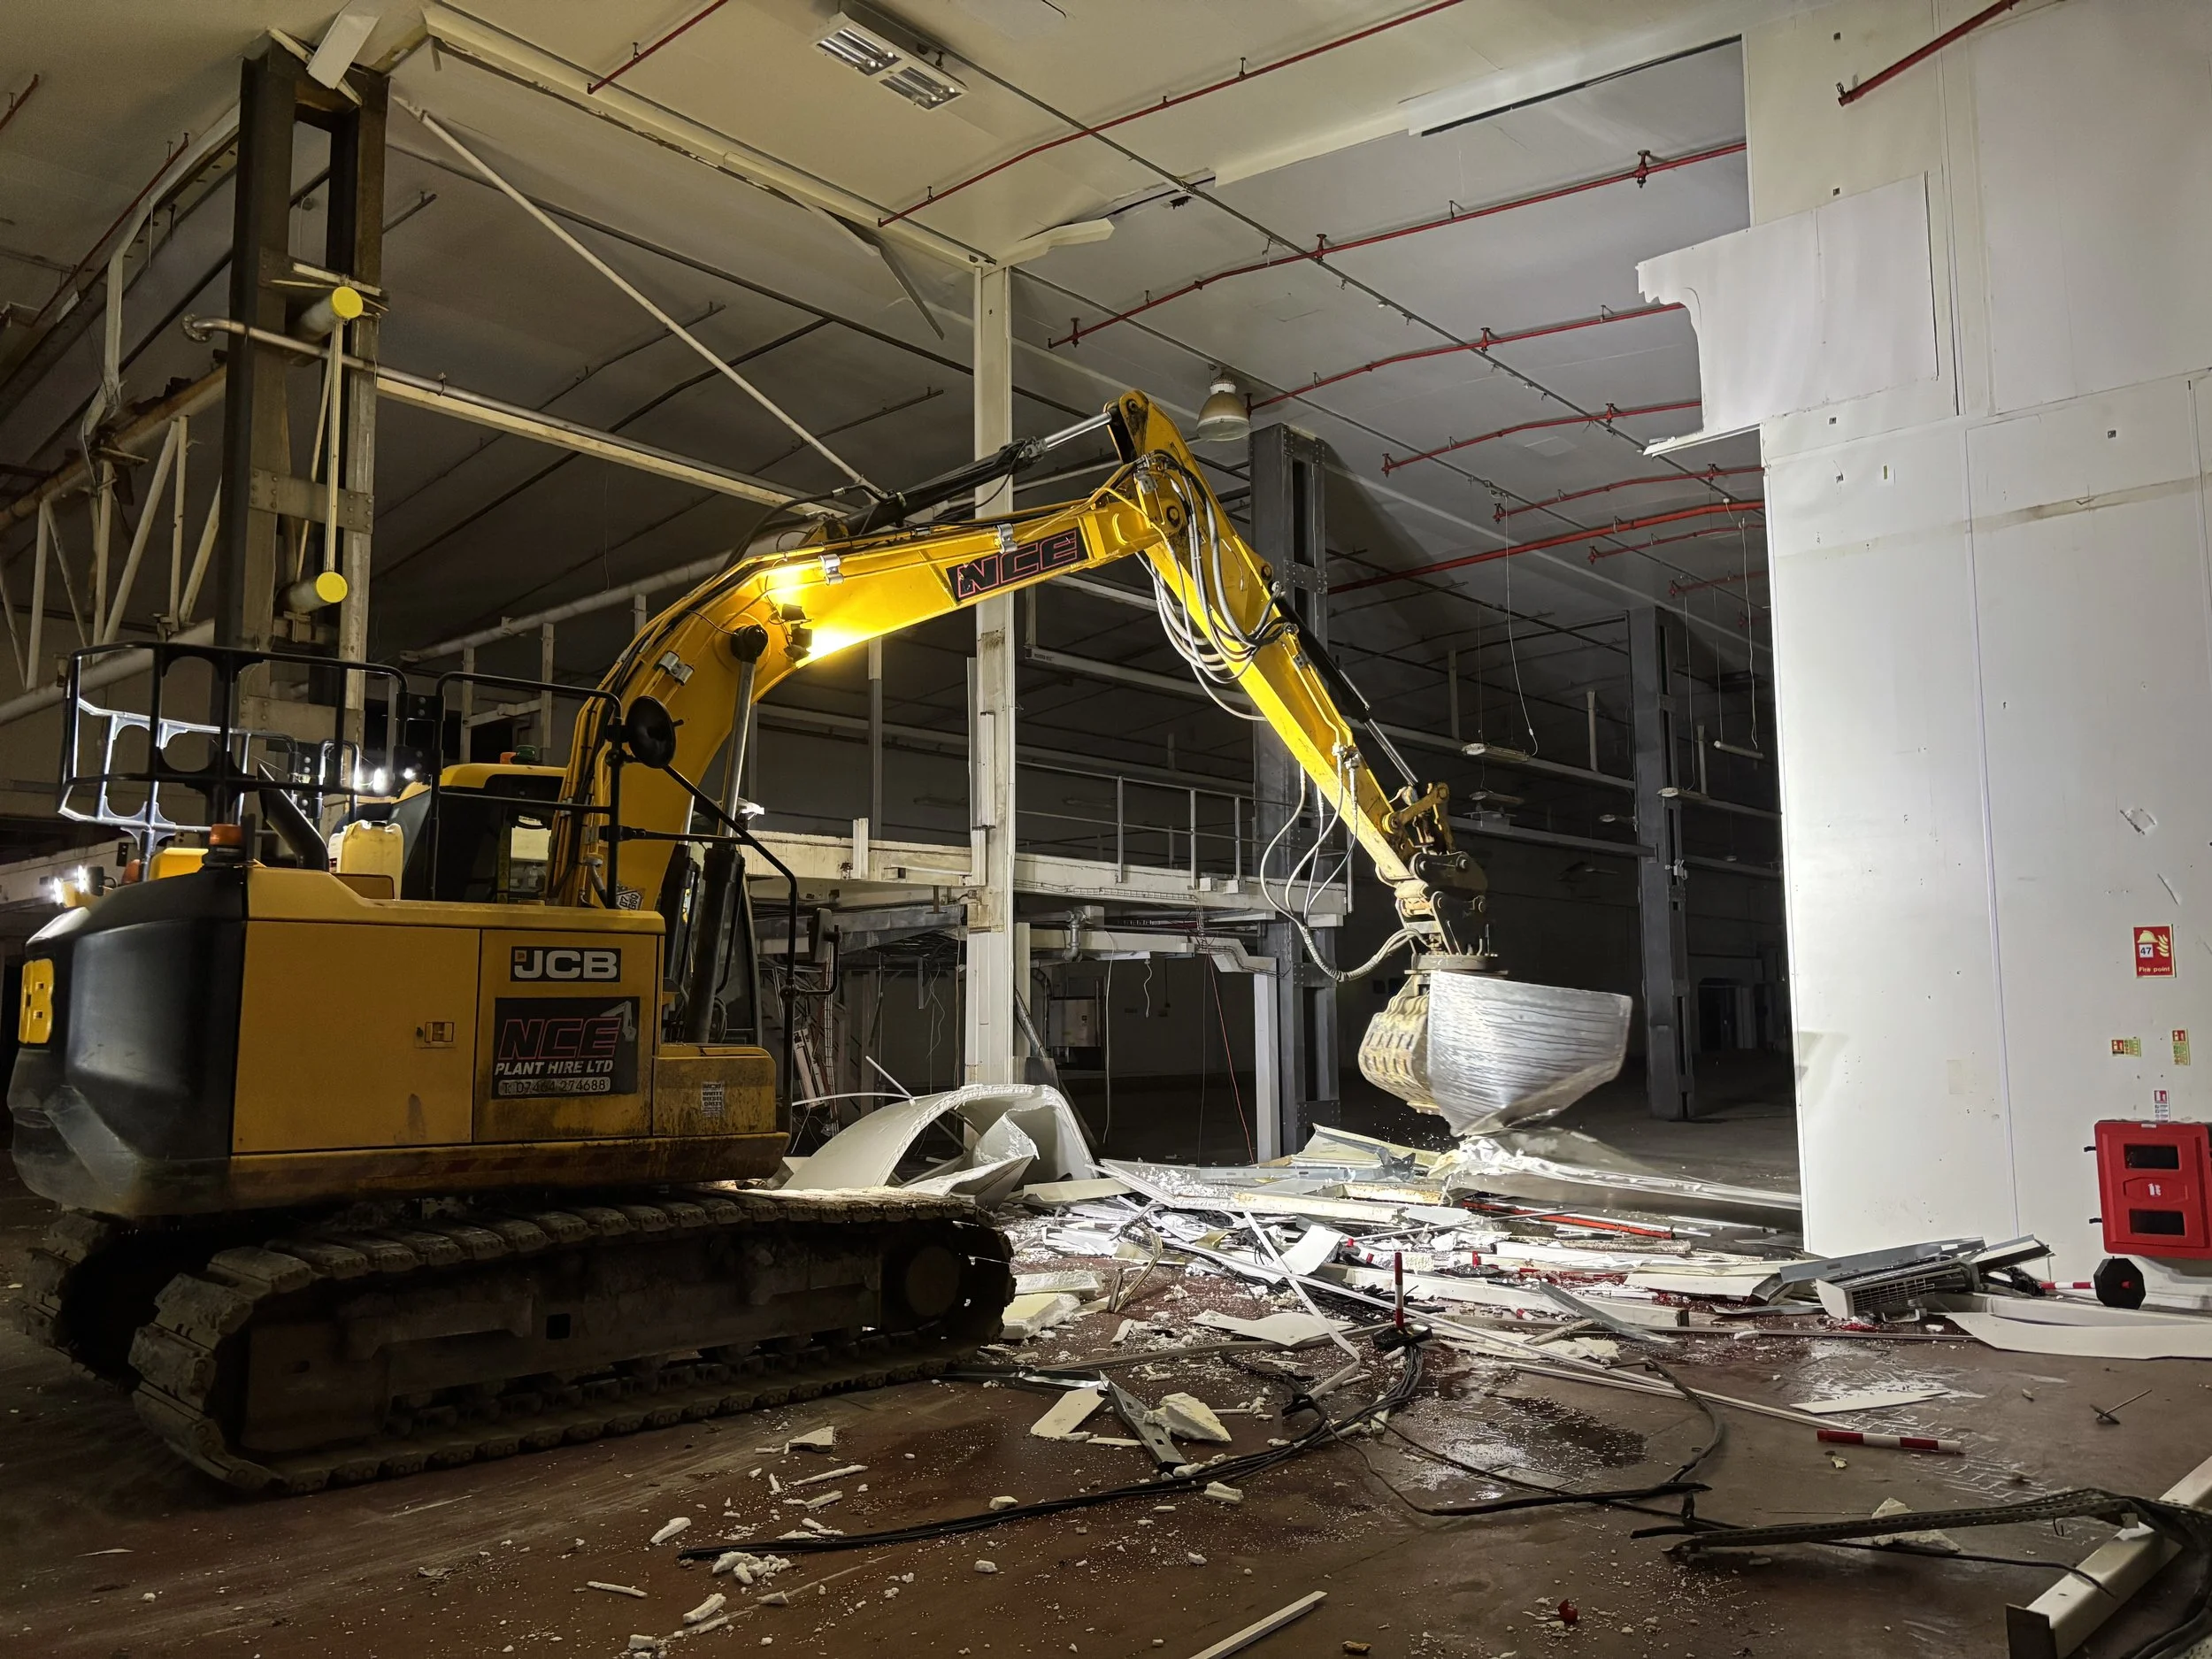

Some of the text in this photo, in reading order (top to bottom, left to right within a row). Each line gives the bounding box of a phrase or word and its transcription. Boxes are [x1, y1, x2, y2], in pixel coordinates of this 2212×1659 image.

[957, 529, 1078, 598] NCE
[2140, 947, 2152, 956] 47
[514, 949, 618, 979] JCB
[498, 1018, 622, 1060] NCE
[495, 1059, 614, 1076] PLANT HIRE LTD
[560, 1079, 606, 1092] 274688
